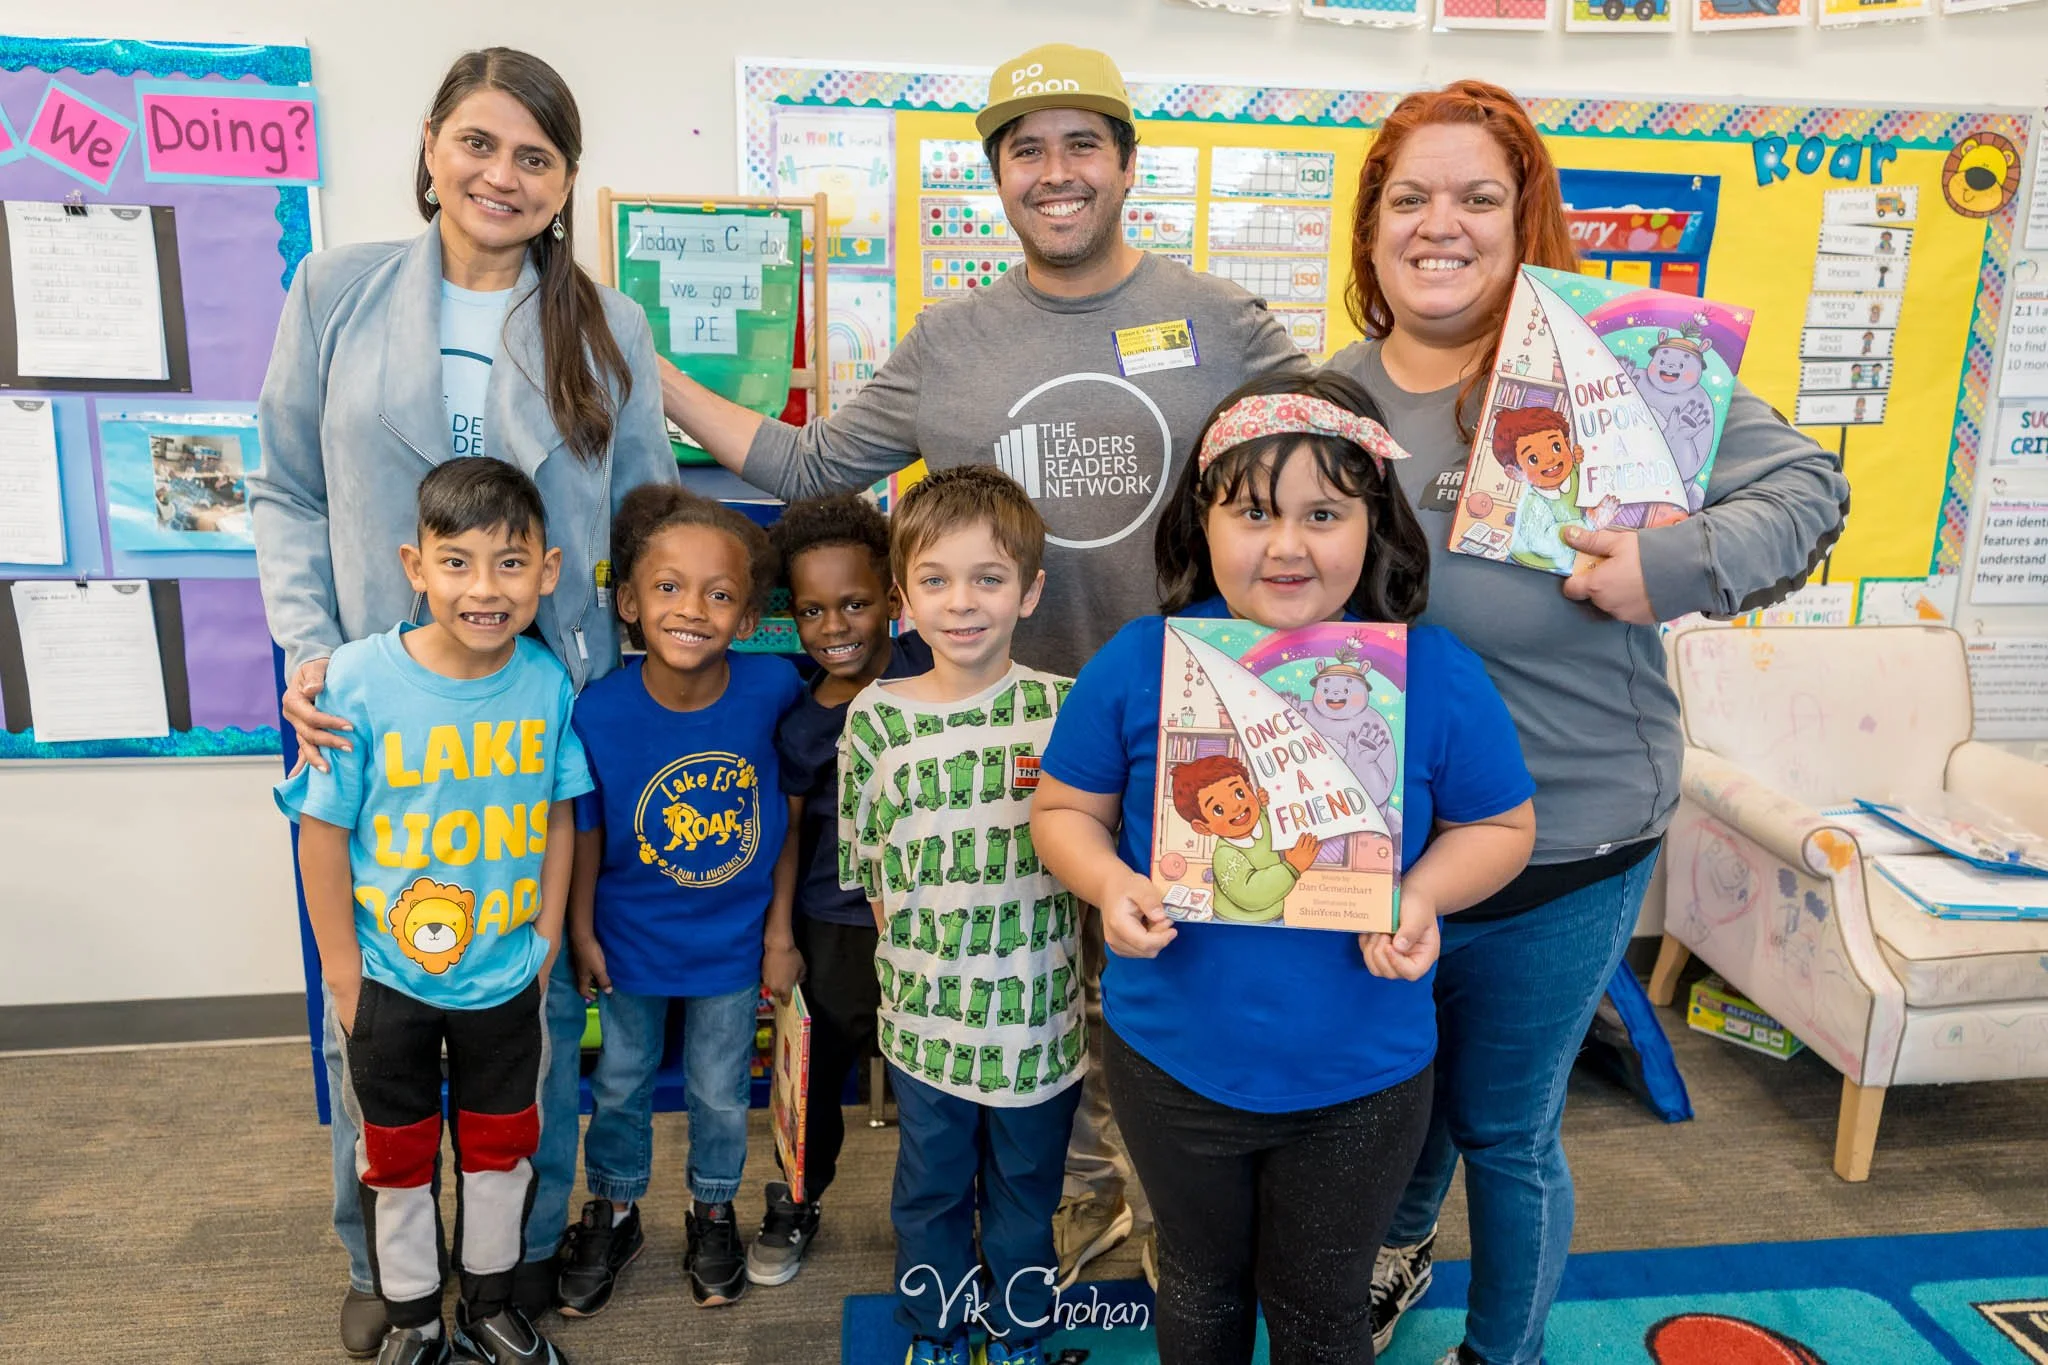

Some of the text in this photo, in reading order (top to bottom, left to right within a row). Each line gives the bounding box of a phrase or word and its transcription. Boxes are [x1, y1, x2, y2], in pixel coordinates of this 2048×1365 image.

[1012, 63, 1043, 85] DO
[1014, 79, 1079, 97] GOOD
[50, 103, 310, 173] We Doing?
[1753, 136, 1897, 187] Roar
[1300, 169, 1325, 183] 130
[1298, 222, 1323, 236] 140
[634, 225, 686, 260] Today
[701, 234, 715, 253] is
[725, 226, 739, 251] C
[1295, 273, 1319, 286] 150
[672, 276, 759, 308] we go to
[2014, 305, 2031, 317] 2.1
[695, 317, 720, 341] PE
[2012, 325, 2024, 335] to
[1122, 345, 1161, 357] VOLUNTEER
[2009, 343, 2022, 353] to
[1575, 373, 1632, 408] ONCE
[1040, 422, 1076, 438] THE
[1580, 402, 1648, 438] UPON
[1044, 435, 1136, 458] LEADERS
[1045, 455, 1138, 478] READERS
[1587, 460, 1673, 493] FRIEND
[1046, 475, 1152, 498] NETWORK
[1994, 518, 2012, 528] can
[1984, 535, 2030, 547] features
[1980, 553, 2046, 565] understand
[1977, 572, 2004, 585] they
[2006, 573, 2025, 583] are
[1245, 708, 1302, 748] ONCE
[384, 719, 546, 788] LAKE
[1256, 731, 1327, 778] UPON
[660, 767, 738, 802] Lake ES
[1019, 769, 1040, 777] TNT
[1296, 769, 1314, 794] A
[1275, 787, 1367, 834] FRIEND
[373, 800, 548, 870] LIONS
[673, 809, 740, 842] ROAR
[1299, 883, 1316, 892] Dan
